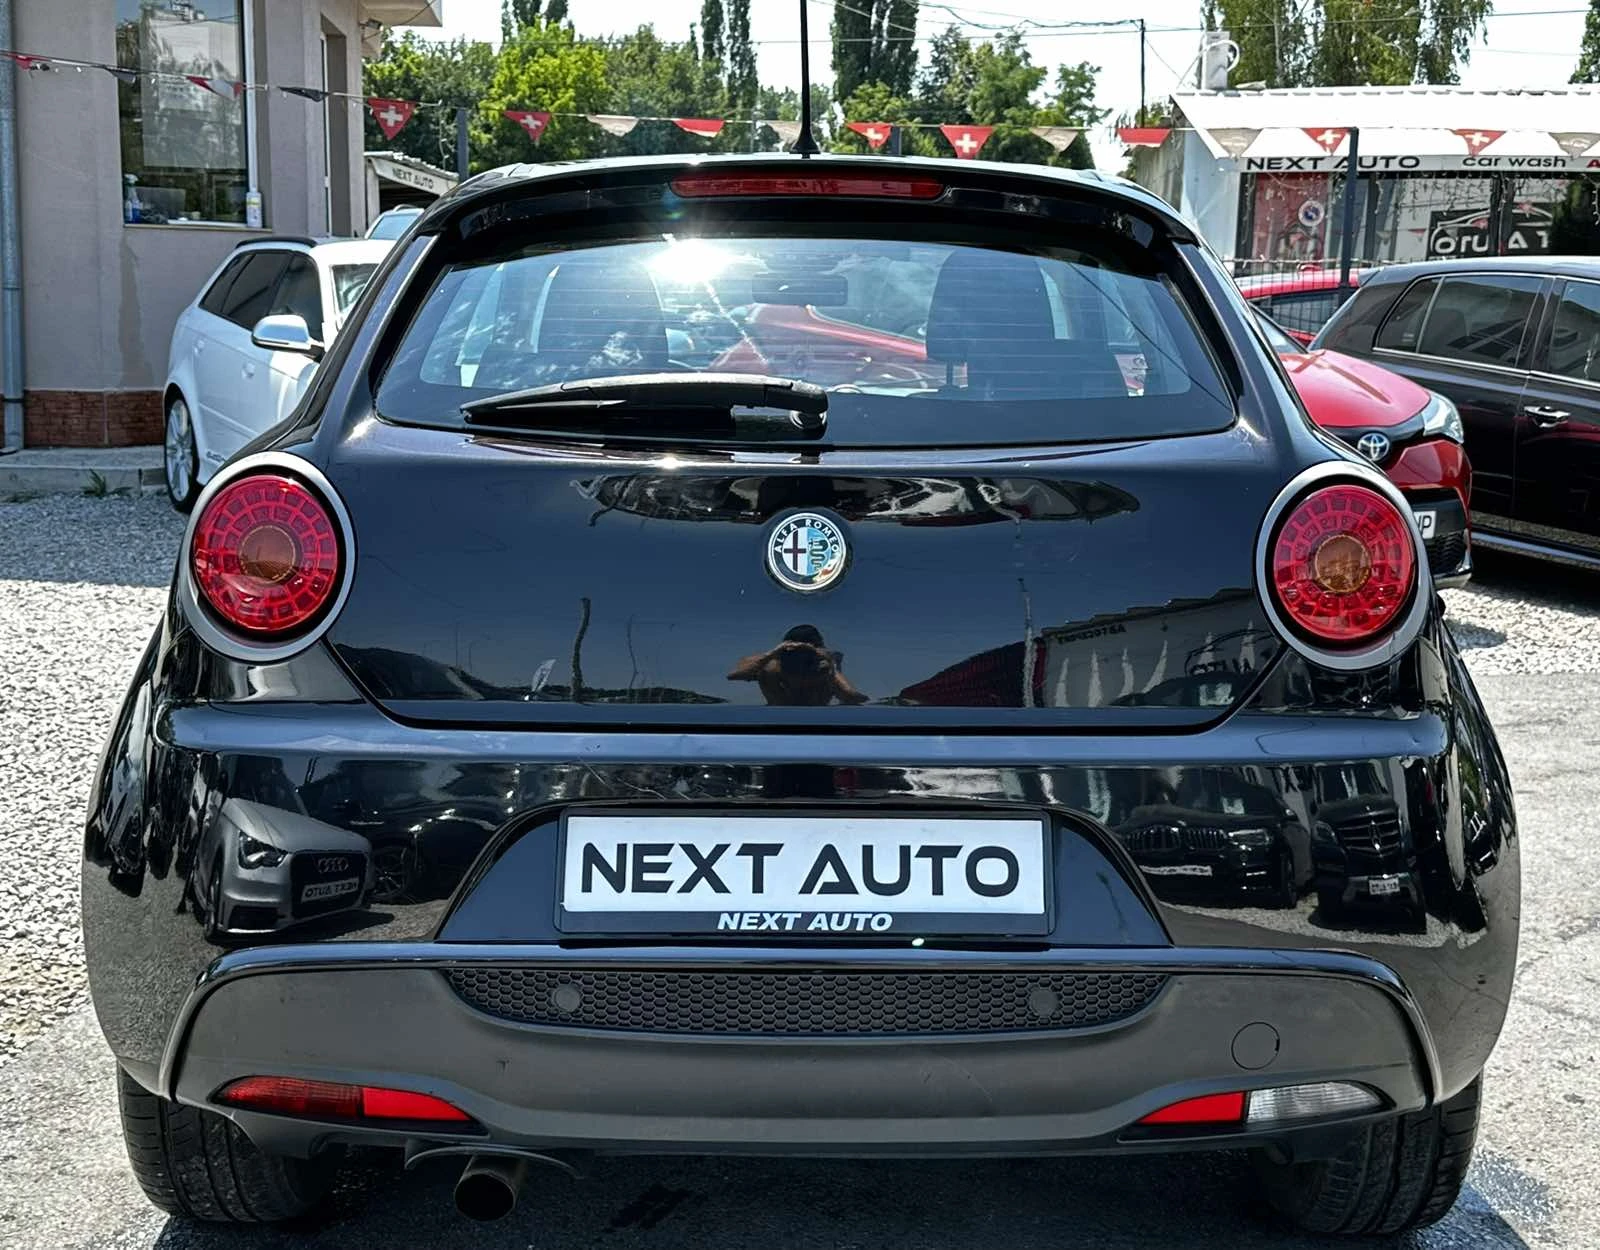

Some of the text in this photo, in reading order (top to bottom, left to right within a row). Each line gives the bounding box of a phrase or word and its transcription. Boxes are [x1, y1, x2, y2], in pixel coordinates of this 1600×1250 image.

[1247, 156, 1420, 170] NEXT AUTO
[1463, 156, 1566, 168] car wash
[392, 167, 434, 190] NEXT AUTO
[774, 518, 840, 553] ALFA ROMEO
[581, 842, 1020, 898] NEXT AUTO
[717, 912, 894, 932] NEXT AUTO
